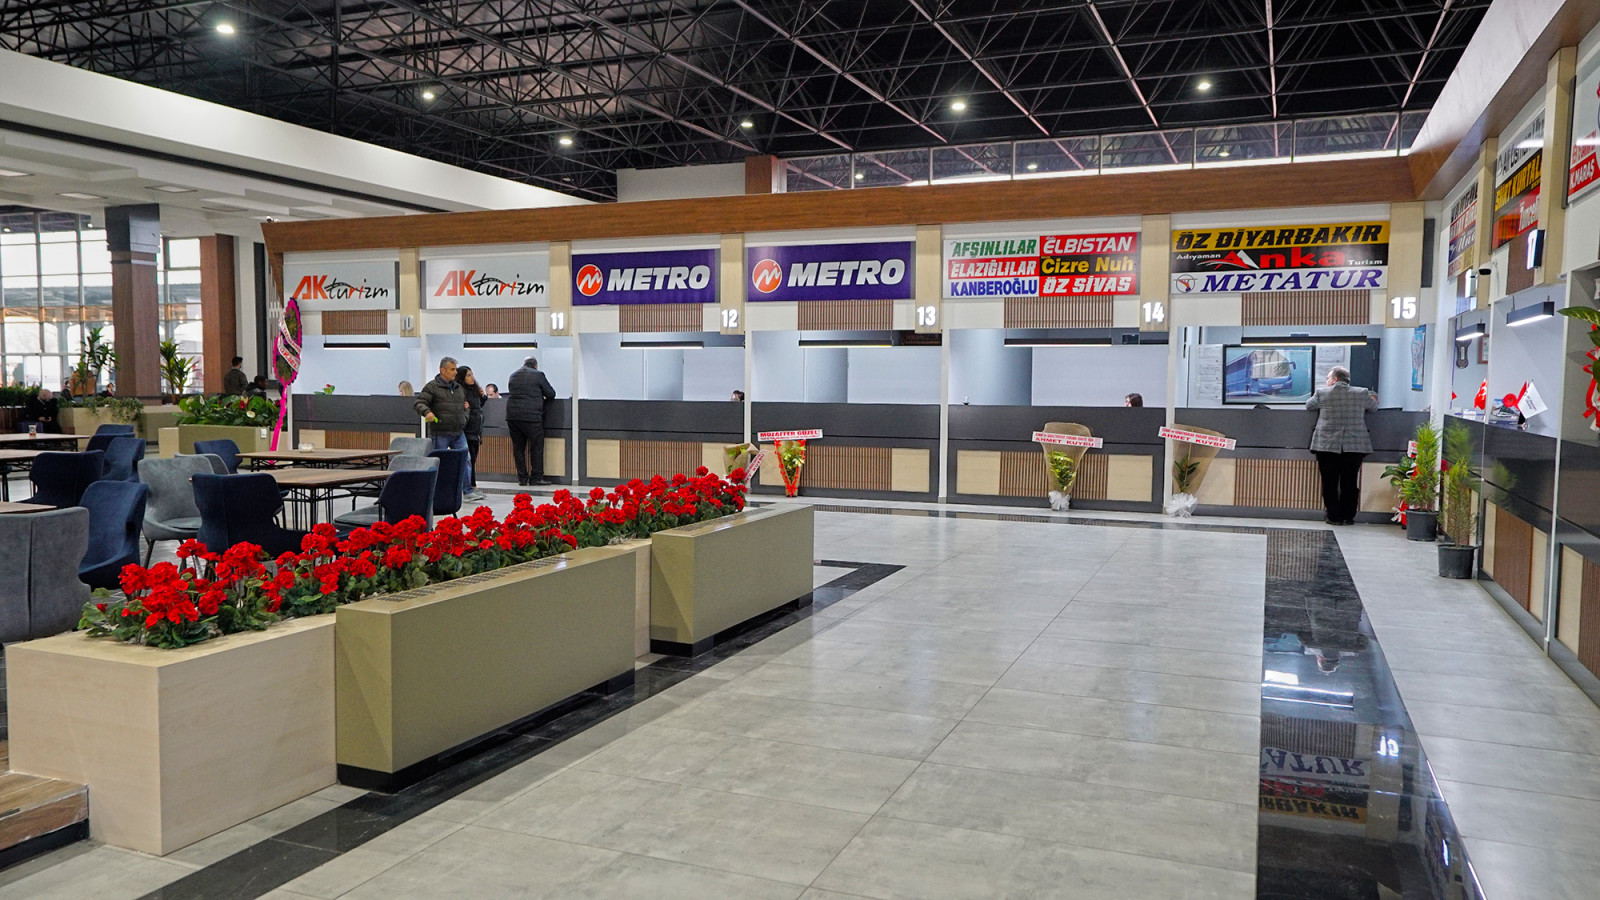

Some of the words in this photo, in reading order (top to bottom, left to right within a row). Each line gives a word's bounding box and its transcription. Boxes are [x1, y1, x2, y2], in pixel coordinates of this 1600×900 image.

[1176, 231, 1212, 250] ÖZ
[1216, 224, 1383, 249] DİYARBAKIR
[1041, 257, 1090, 274] Cizre
[1095, 256, 1134, 272] Nuh
[1347, 257, 1383, 266] Turizm
[606, 264, 711, 292] METRO
[787, 258, 906, 287] METRO
[1200, 269, 1383, 293] METATUR
[951, 278, 1038, 297] KANBEROĞLU
[1042, 276, 1070, 294] ÖZ
[1072, 275, 1132, 293] SİVAS
[721, 309, 738, 328] 12
[916, 305, 937, 326] 13
[1142, 301, 1165, 323] 14
[1390, 296, 1417, 320] 15
[550, 311, 566, 331] 11
